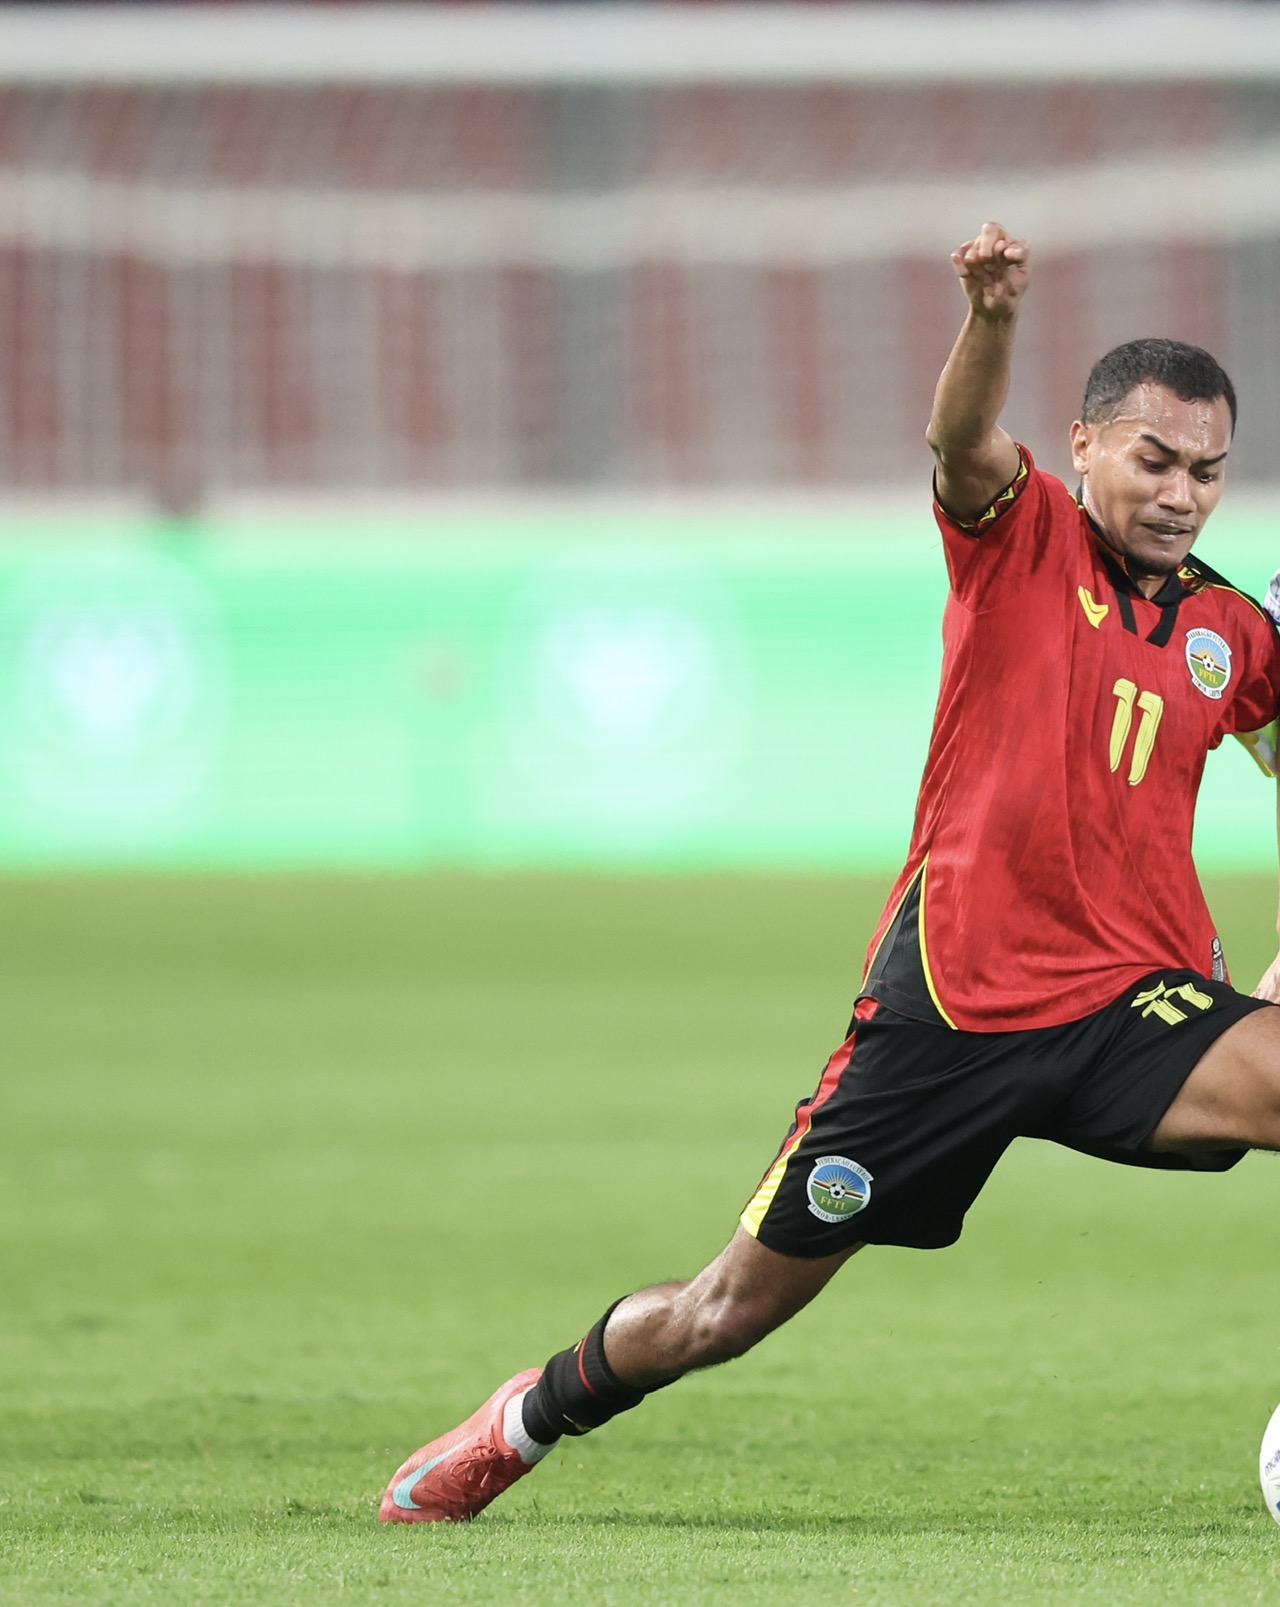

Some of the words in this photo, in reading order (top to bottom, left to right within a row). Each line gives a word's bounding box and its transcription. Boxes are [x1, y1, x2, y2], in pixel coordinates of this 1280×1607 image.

[1109, 678, 1164, 786] 11
[1141, 981, 1214, 1026] 11
[848, 1162, 871, 1182] FUTEBOL
[819, 1195, 847, 1212] FFTL
